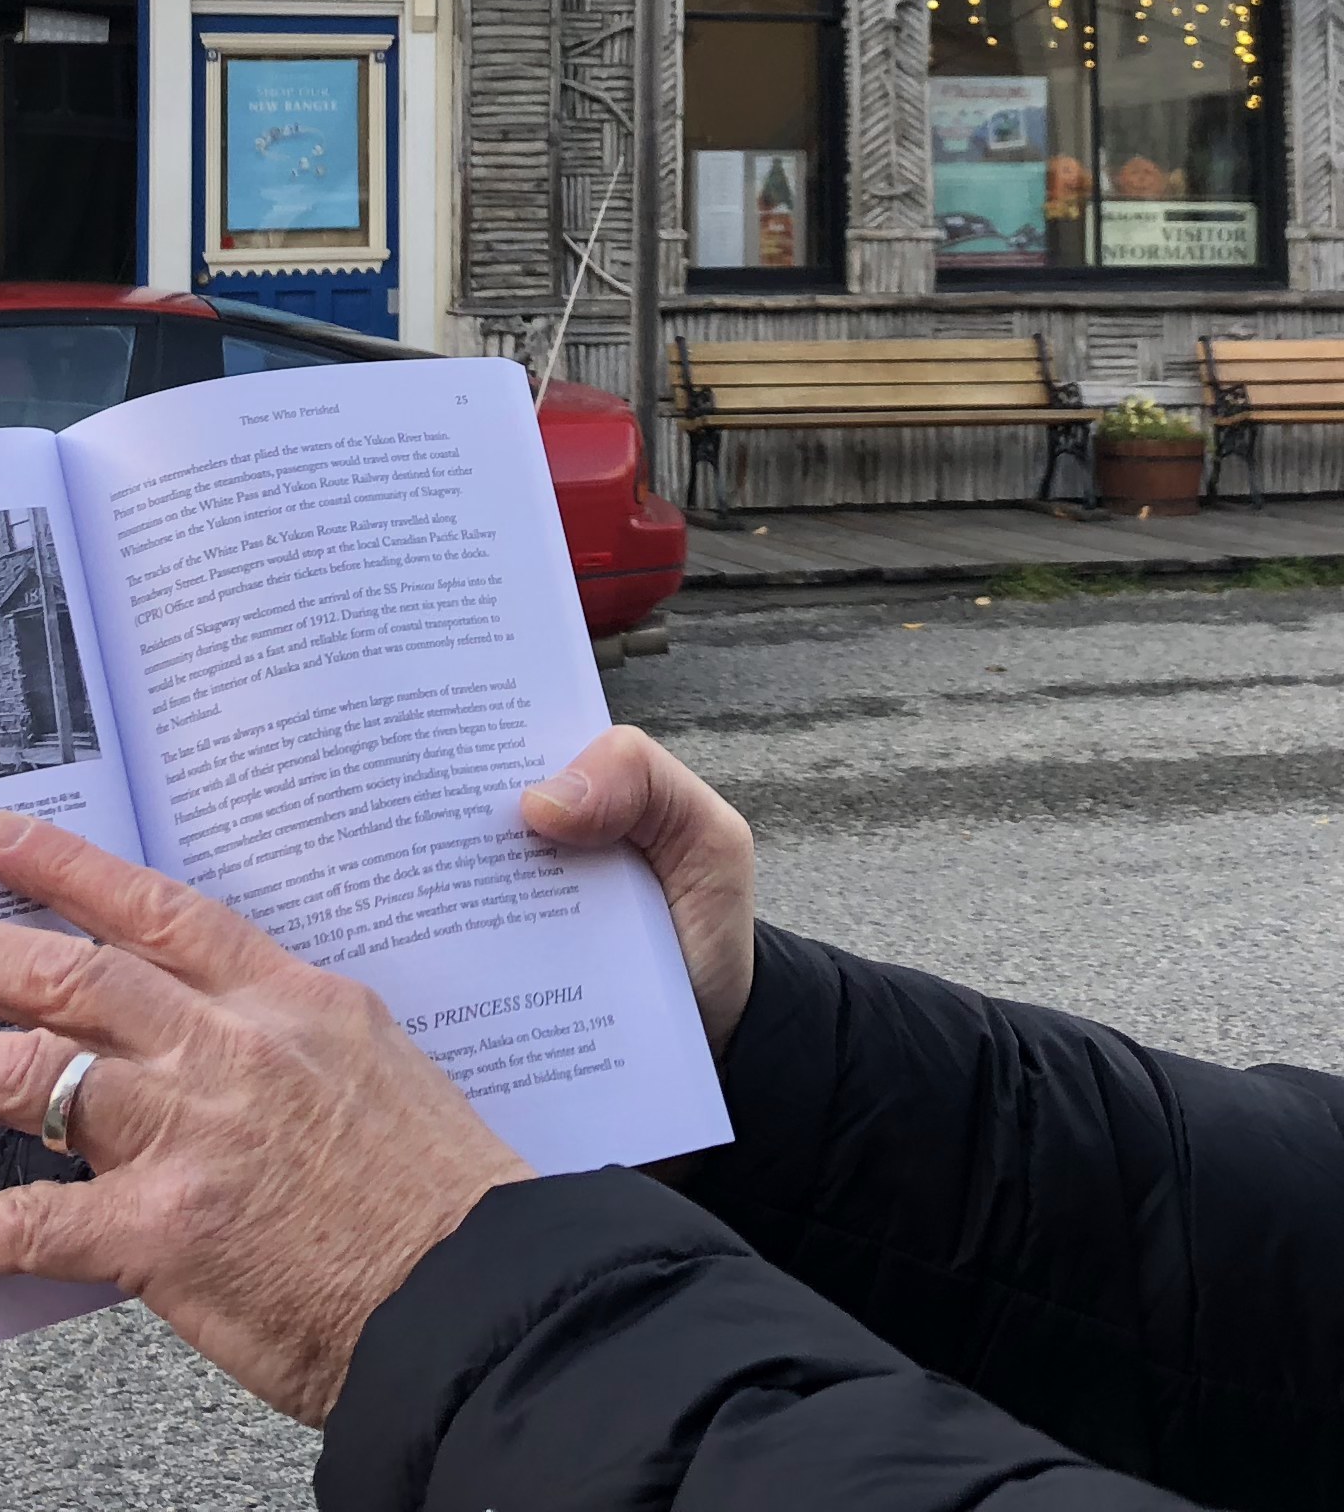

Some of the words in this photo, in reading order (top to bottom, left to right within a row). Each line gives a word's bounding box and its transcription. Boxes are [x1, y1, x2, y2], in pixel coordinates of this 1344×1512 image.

[1162, 226, 1247, 242] VISITOR
[1101, 244, 1250, 260] NFORMATION
[240, 414, 270, 425] Those
[272, 408, 297, 420] Who
[299, 403, 340, 416] Perished
[455, 394, 469, 405] 25
[254, 446, 280, 462] plied
[282, 443, 299, 455] the
[300, 441, 333, 452] waters
[346, 436, 363, 447] the
[364, 435, 396, 445] Yukon
[397, 433, 422, 442] River
[200, 494, 234, 512] White
[237, 492, 259, 503] Pass
[262, 485, 282, 498] and
[283, 482, 317, 494] Yukon
[320, 475, 349, 488] Route
[352, 473, 390, 484] Railway
[207, 515, 242, 530] Yukon
[244, 506, 283, 521] interior
[299, 498, 316, 510] the
[204, 543, 239, 561] White
[241, 539, 264, 551] Pass
[280, 530, 314, 543] Yukon
[317, 522, 348, 536] Route
[350, 520, 388, 531] Railway
[210, 560, 265, 580] Passengers
[267, 550, 300, 566] would
[302, 548, 325, 559] stop
[218, 580, 264, 600] purchase
[266, 571, 292, 586] their
[294, 564, 328, 580] tickets
[330, 562, 361, 573] before
[243, 600, 296, 622] welcomed
[298, 596, 316, 609] the
[318, 590, 351, 605] arrival
[366, 586, 382, 597] the
[384, 583, 398, 594] SS
[341, 608, 379, 621] During
[381, 603, 397, 614] the
[399, 600, 420, 612] next
[310, 630, 348, 647] reliable
[350, 628, 376, 639] form
[390, 619, 423, 632] coastal
[264, 661, 300, 678] Alaska
[303, 656, 323, 669] and
[325, 651, 360, 664] Yukon
[362, 645, 383, 658] that
[385, 644, 404, 654] was
[276, 710, 311, 728] special
[313, 706, 337, 718] time
[339, 700, 368, 712] when
[370, 695, 395, 706] large
[277, 750, 321, 773] personal
[323, 739, 379, 758] belongings
[381, 733, 413, 745] before
[414, 728, 430, 739] the
[264, 777, 296, 795] would
[298, 772, 328, 786] arrive
[343, 762, 361, 775] the
[362, 750, 421, 771] community
[422, 747, 455, 759] during
[266, 800, 302, 817] section
[317, 785, 364, 803] northern
[366, 775, 402, 791] society
[403, 768, 449, 784] including
[256, 844, 303, 864] returning
[318, 832, 335, 846] the
[338, 818, 393, 840] Northland
[395, 814, 412, 826] the
[414, 808, 461, 823] following
[286, 867, 326, 887] months
[339, 860, 359, 872] was
[361, 848, 410, 866] common
[412, 845, 427, 855] for
[303, 889, 324, 904] cast
[326, 884, 342, 898] off
[344, 880, 371, 893] from
[373, 872, 391, 886] the
[393, 866, 421, 881] dock
[335, 903, 353, 917] the
[355, 899, 371, 912] SS
[374, 891, 415, 907] Princess
[417, 881, 451, 897] Sophia
[373, 915, 394, 929] and
[396, 910, 414, 924] the
[416, 904, 458, 919] weather
[460, 899, 479, 910] was
[347, 944, 366, 958] call
[369, 939, 390, 953] and
[392, 929, 431, 947] headed
[434, 922, 463, 937] south
[408, 1016, 429, 1034] SS
[434, 995, 521, 1028] PRINCESS
[525, 986, 583, 1008] SOPHIA
[479, 1034, 514, 1051] Alaska
[531, 1026, 571, 1040] October
[477, 1058, 507, 1074] south
[509, 1056, 524, 1066] for
[526, 1051, 543, 1063] the
[545, 1047, 575, 1060] winter
[578, 1040, 596, 1053] and
[512, 1075, 532, 1088] and
[534, 1070, 572, 1084] bidding
[574, 1058, 612, 1076] farewell
